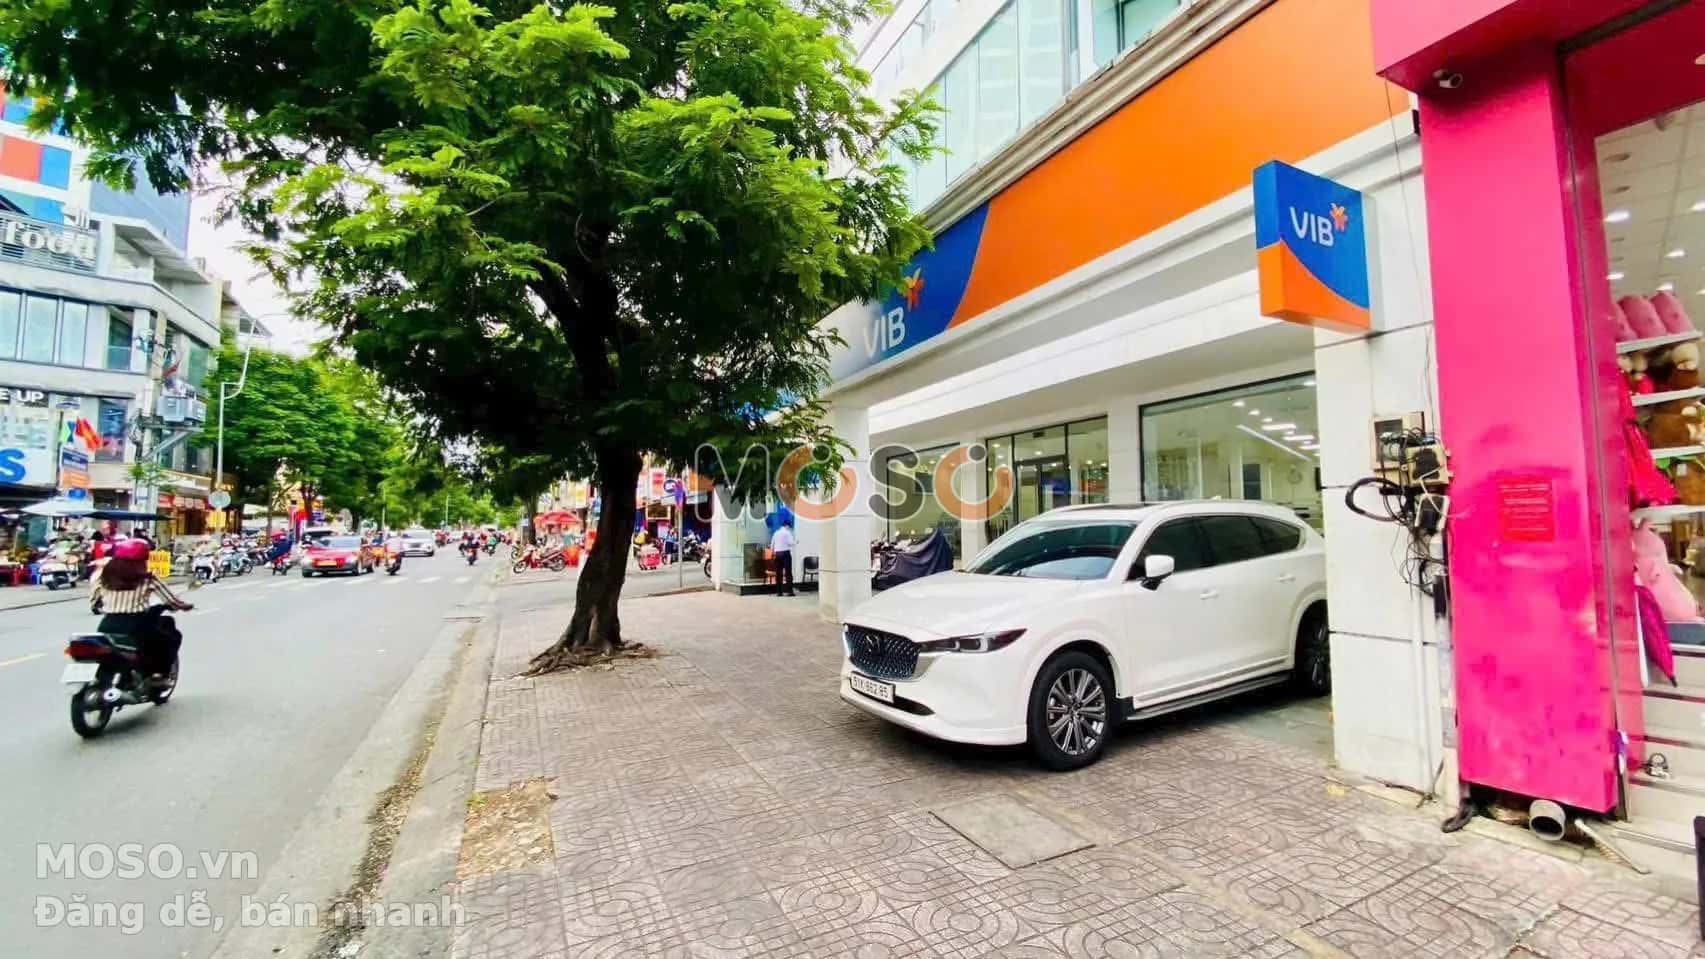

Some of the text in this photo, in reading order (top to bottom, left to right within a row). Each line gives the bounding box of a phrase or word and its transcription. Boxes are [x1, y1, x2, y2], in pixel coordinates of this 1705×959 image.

[1288, 206, 1334, 247] VIB
[863, 306, 905, 357] VIB
[16, 390, 44, 402] UP
